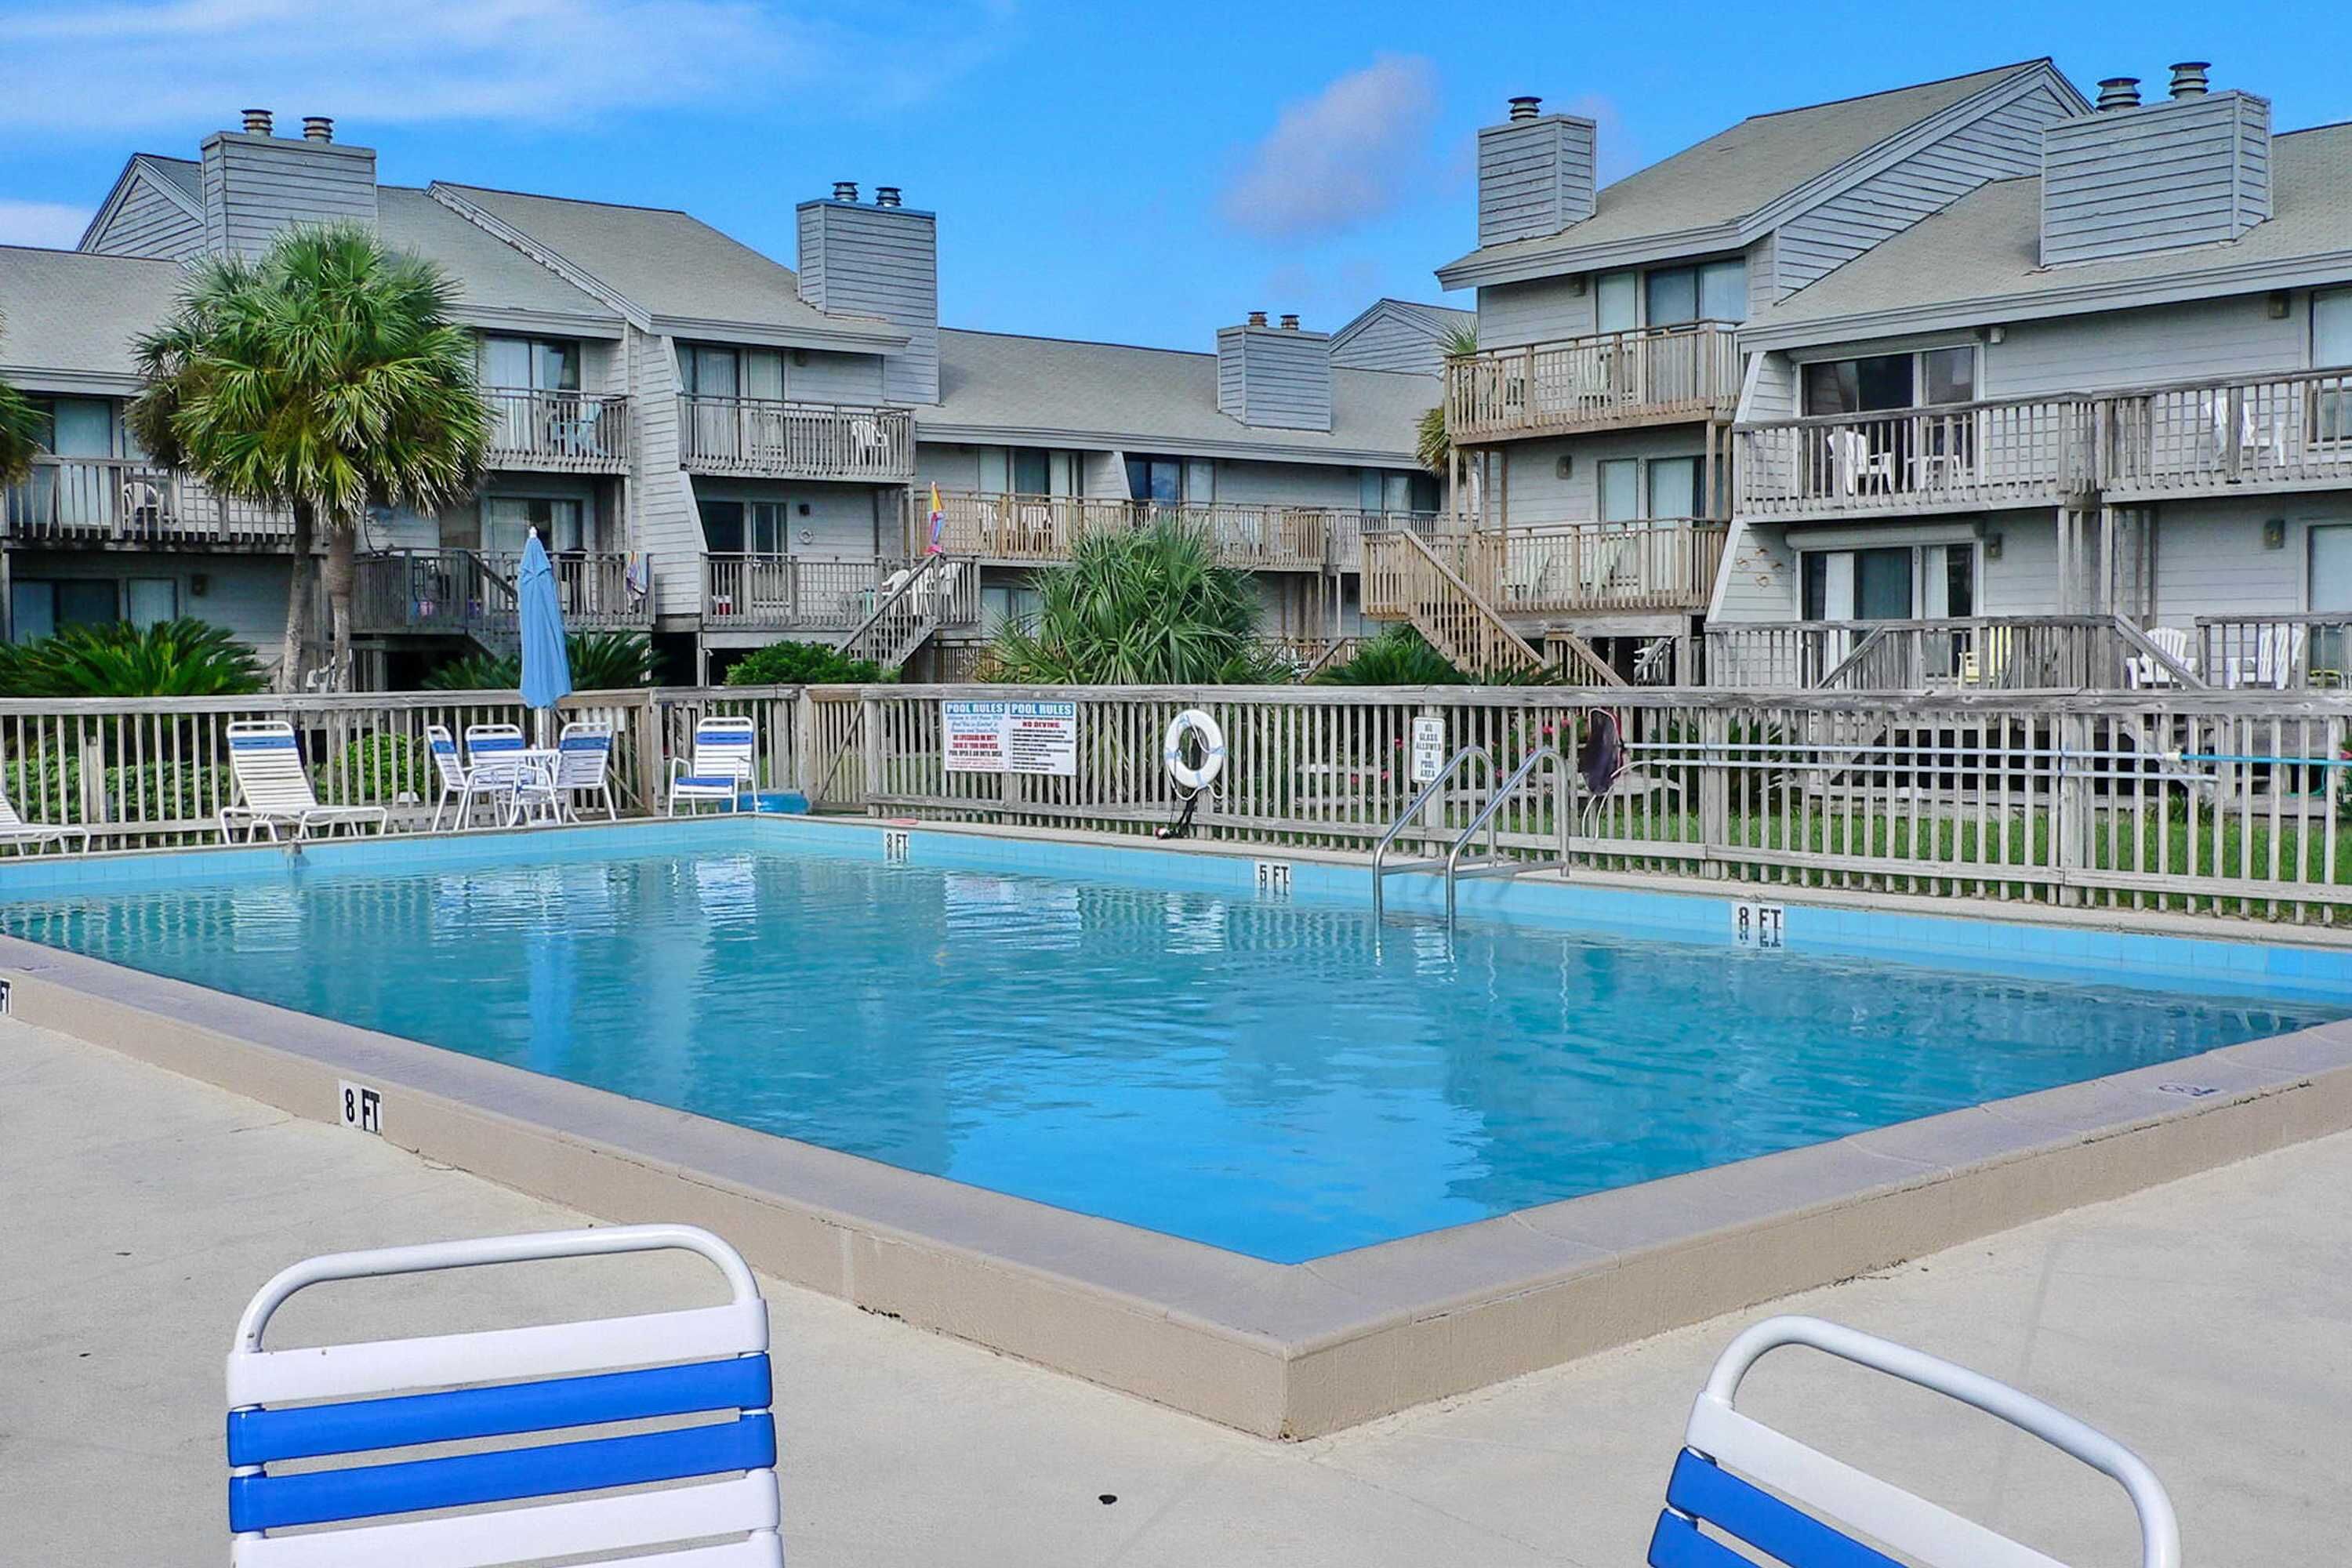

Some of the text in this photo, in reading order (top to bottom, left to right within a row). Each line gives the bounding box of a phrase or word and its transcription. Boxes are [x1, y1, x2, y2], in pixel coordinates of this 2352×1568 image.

[946, 703, 1003, 713] POOL RULES
[1011, 703, 1071, 715] POOL RULES
[345, 1088, 380, 1131] 8 FT
